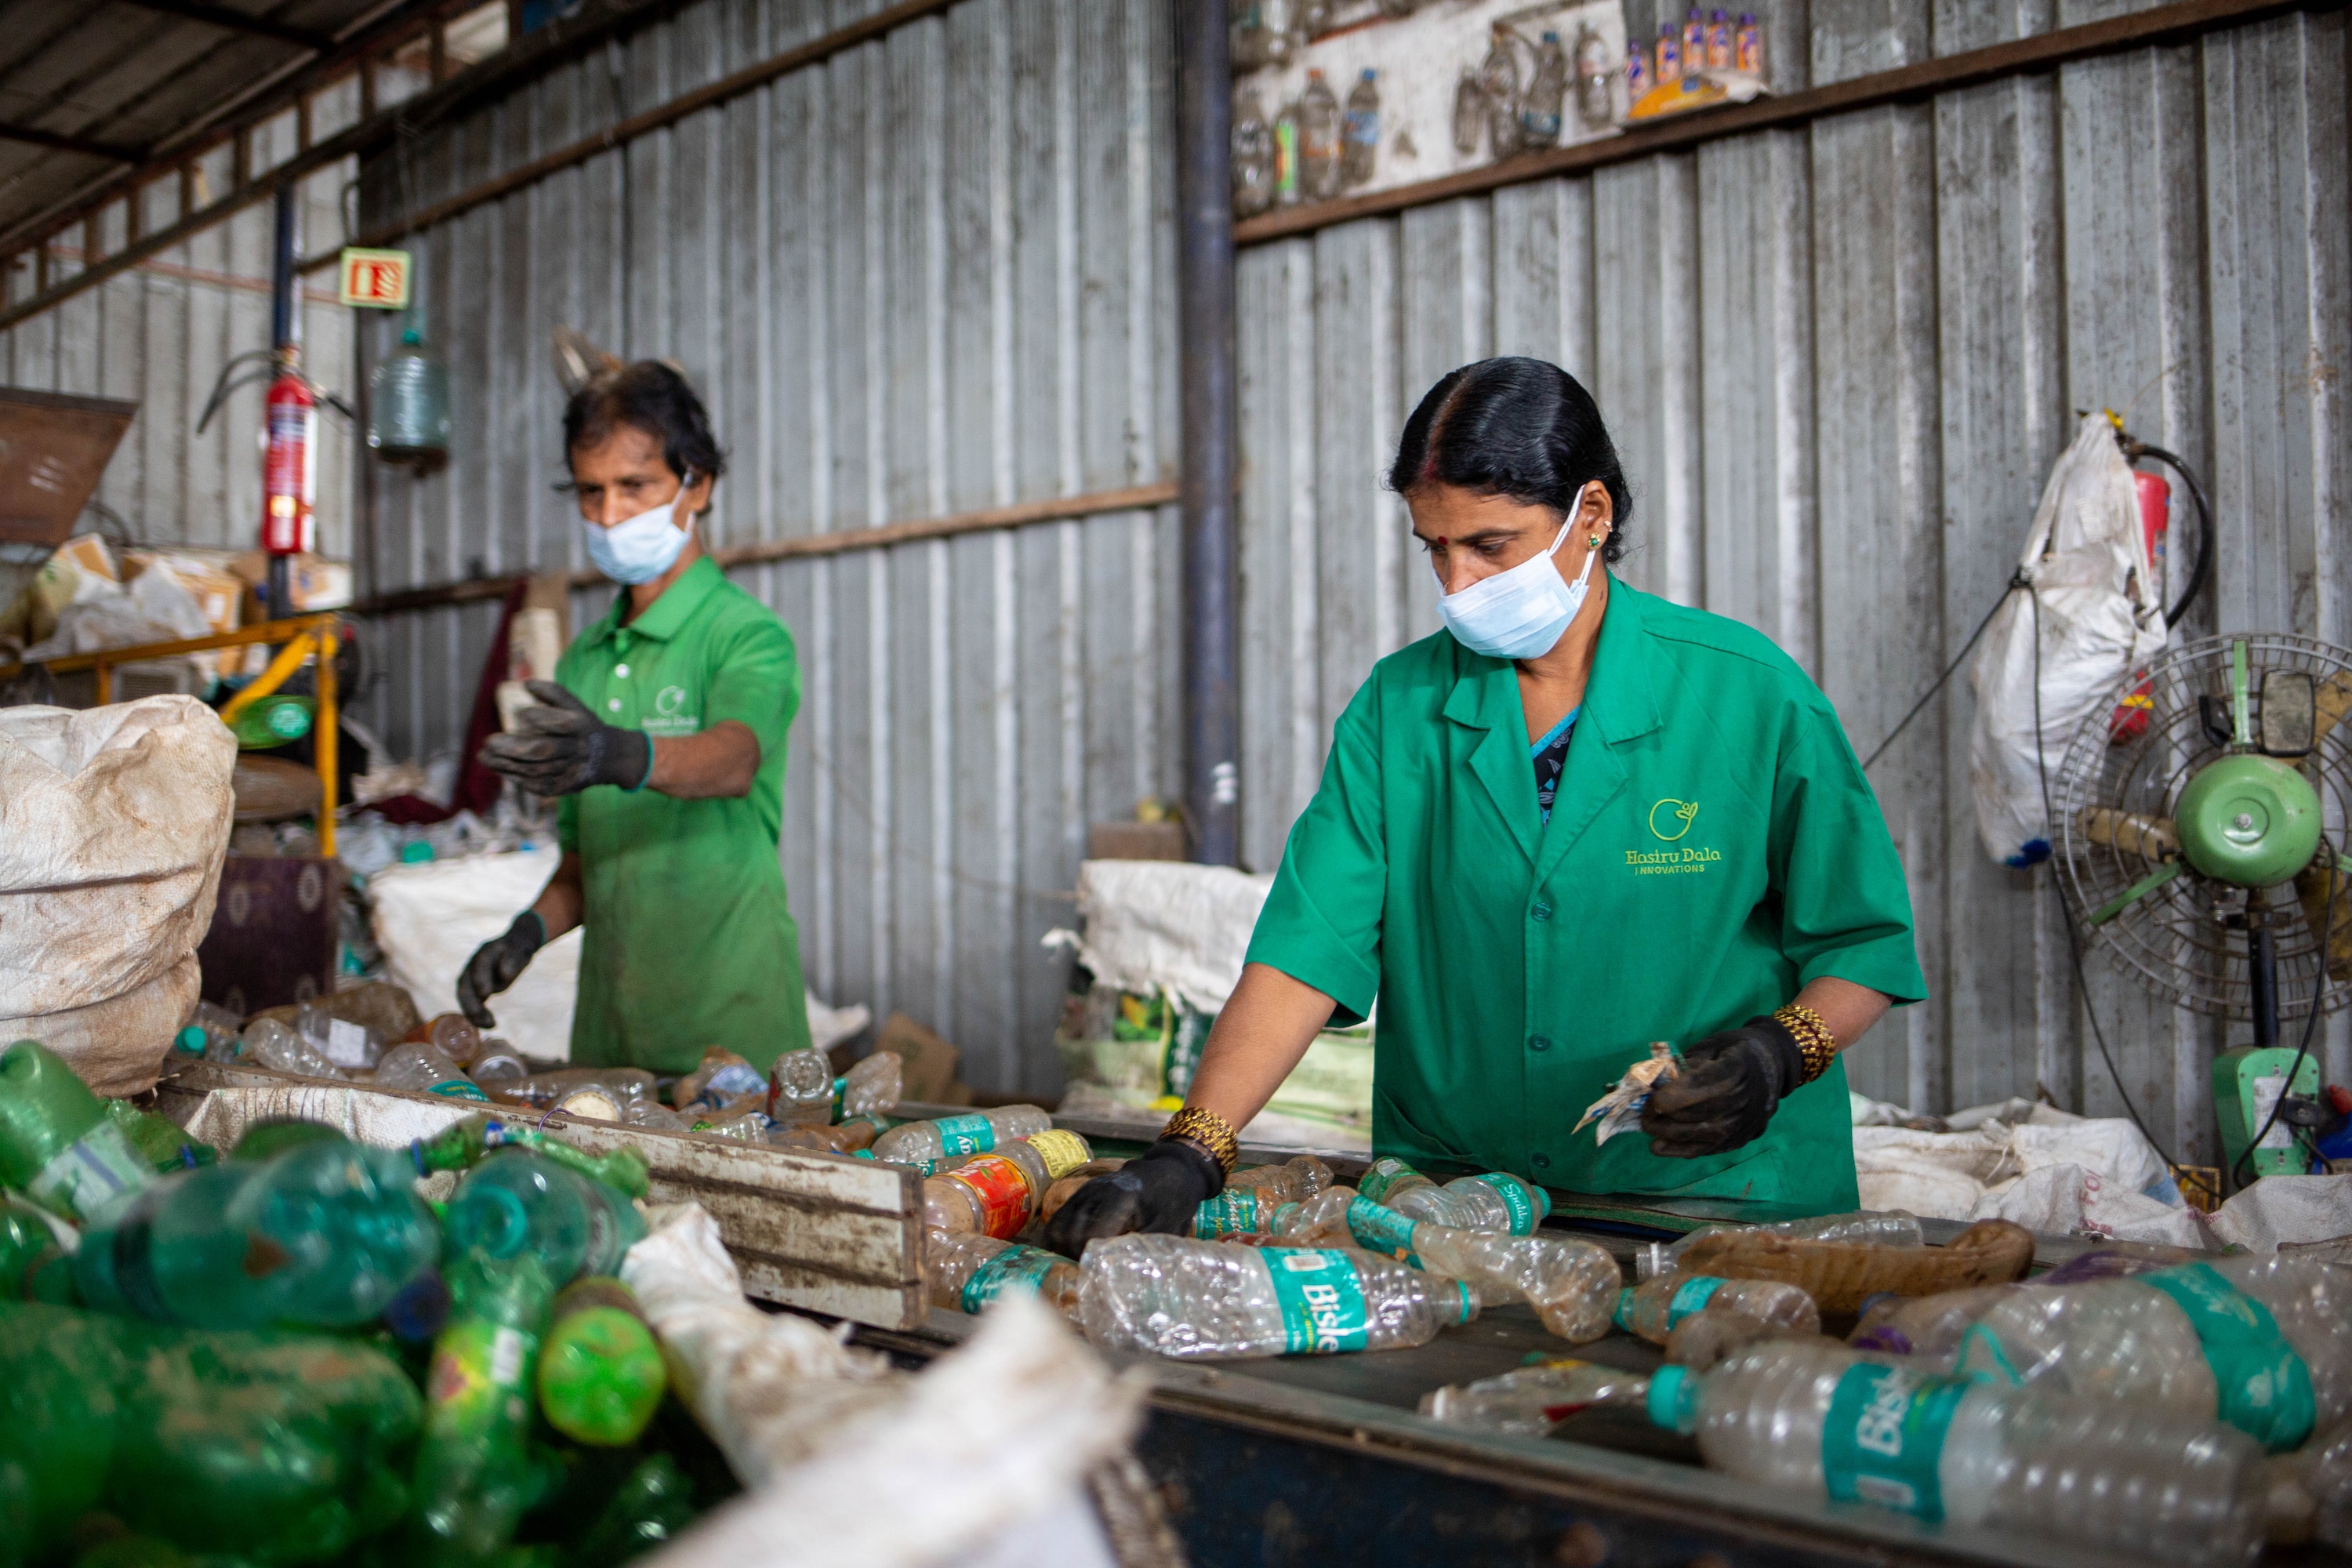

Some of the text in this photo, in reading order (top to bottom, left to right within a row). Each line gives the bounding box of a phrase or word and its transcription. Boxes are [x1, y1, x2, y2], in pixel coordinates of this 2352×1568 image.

[1625, 848, 1722, 864] Hasiru Dala
[1635, 864, 1705, 876] INNOVATIONS
